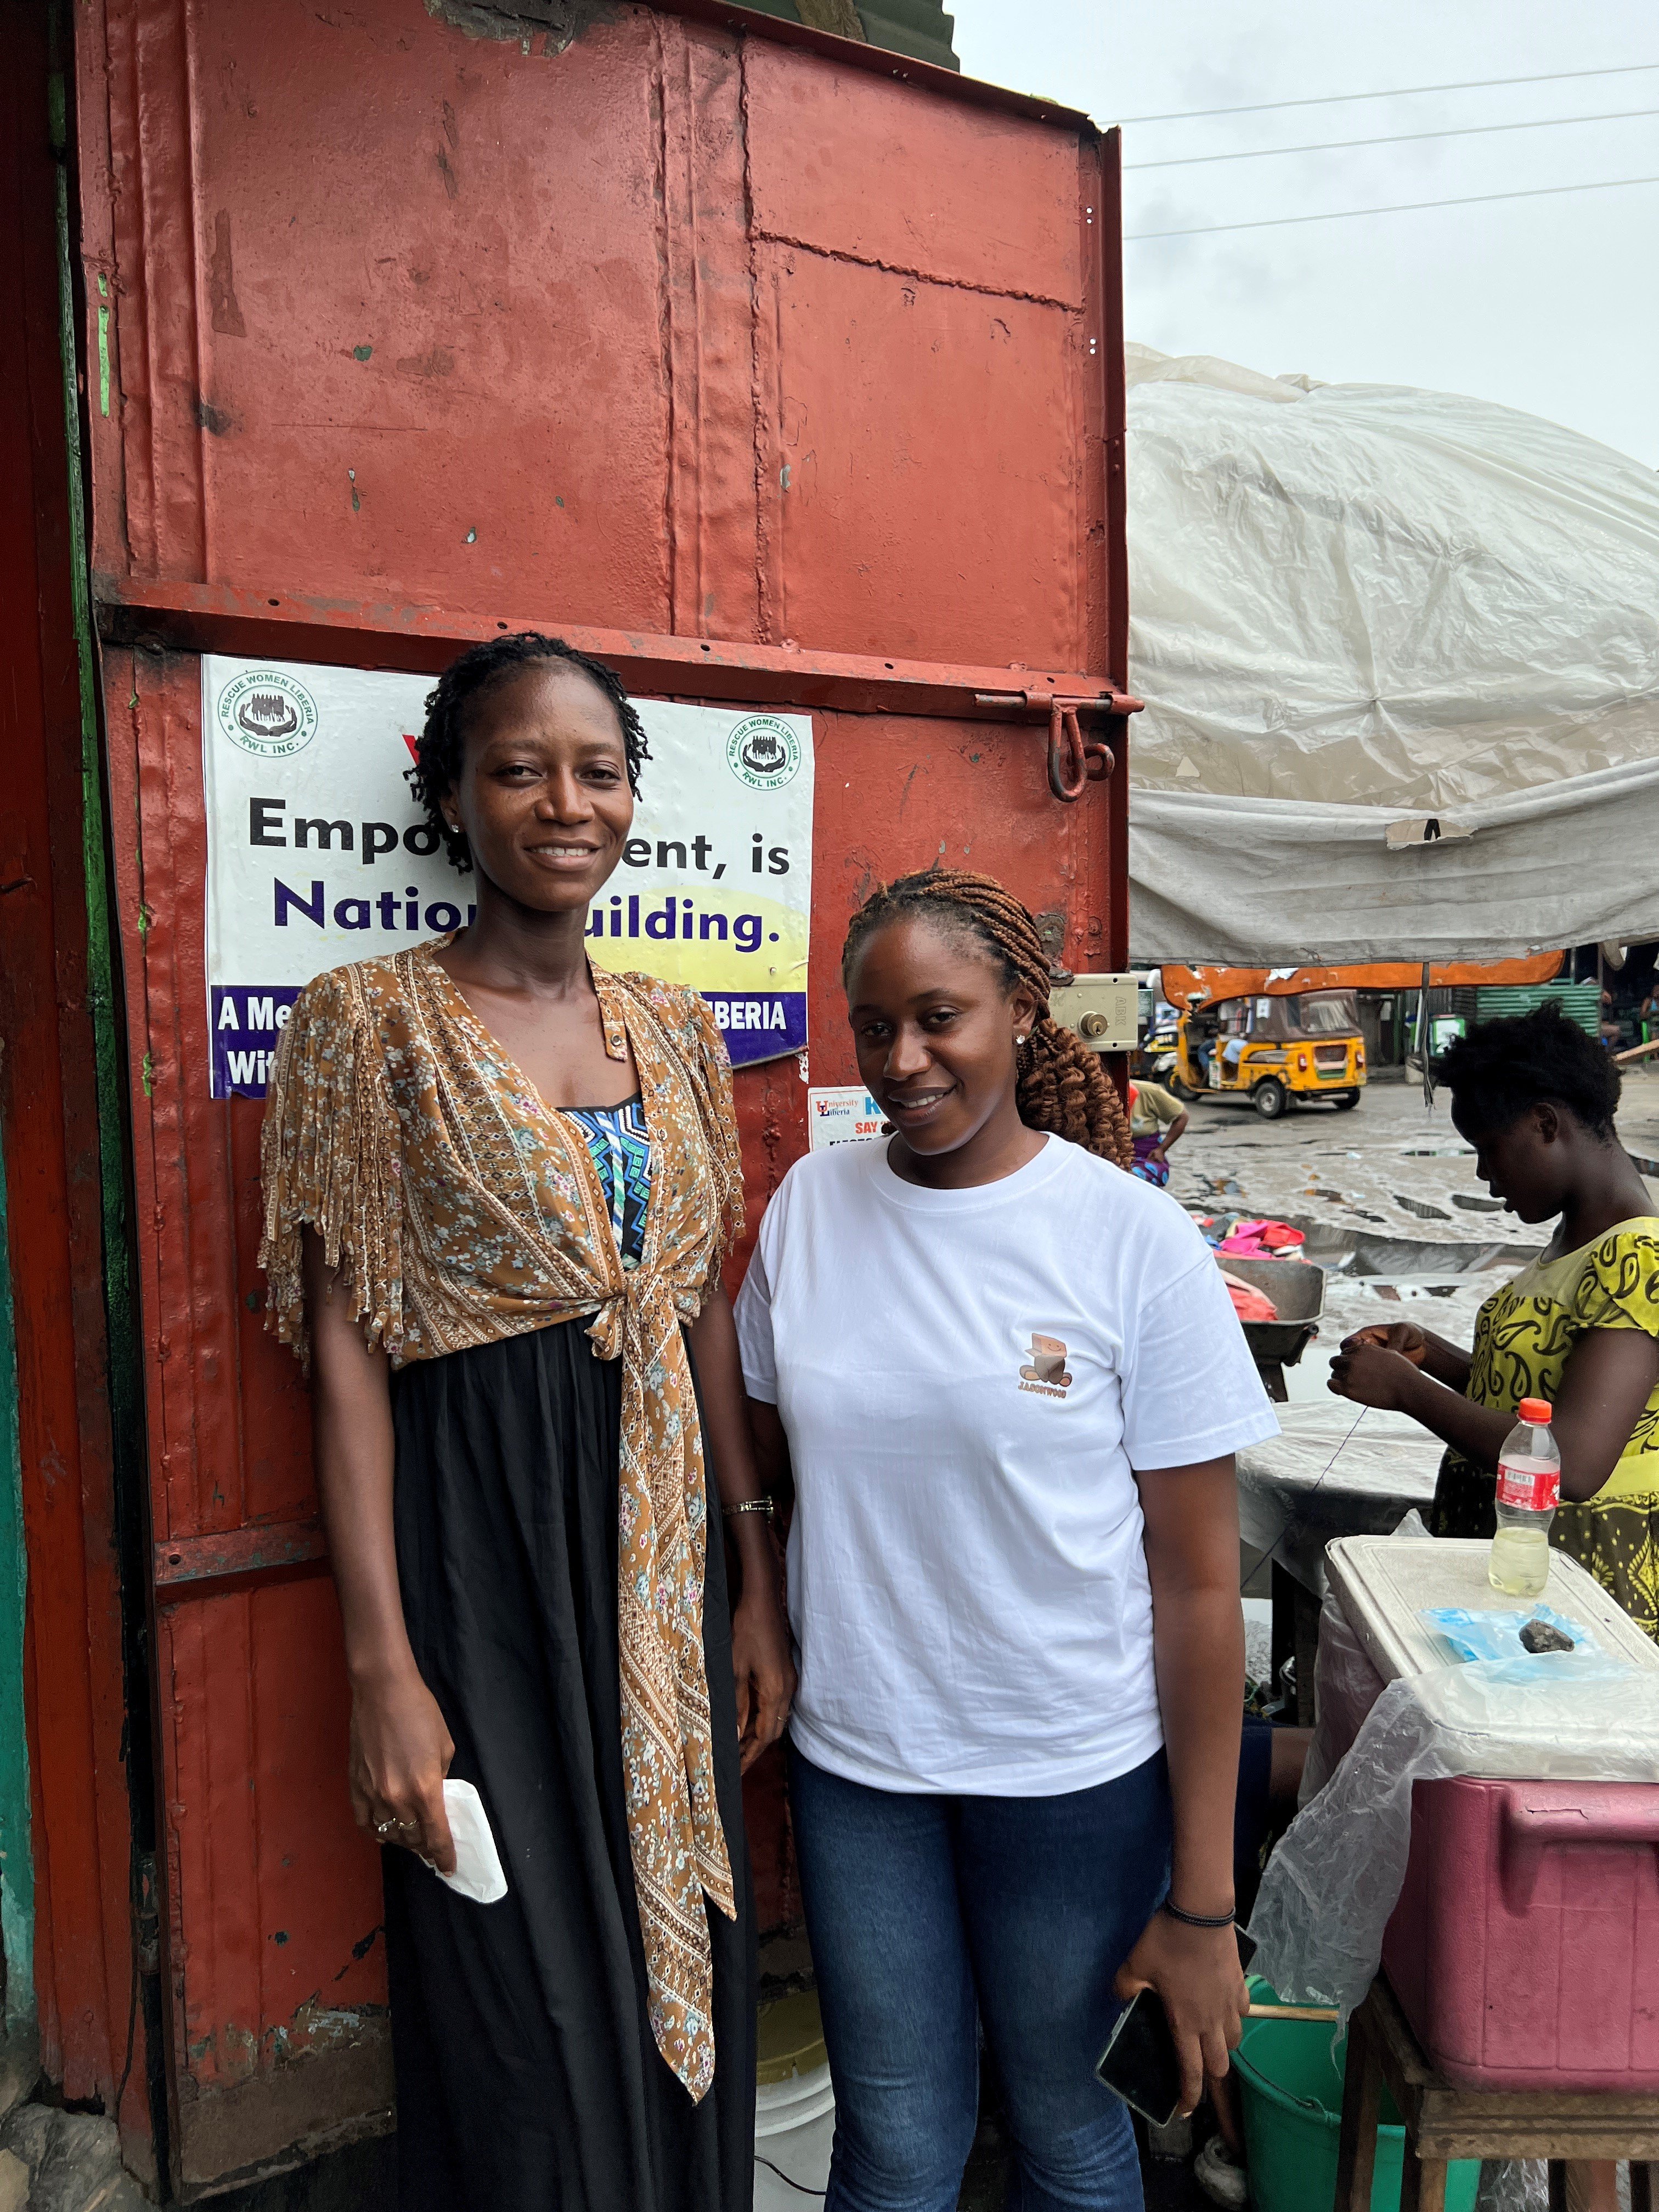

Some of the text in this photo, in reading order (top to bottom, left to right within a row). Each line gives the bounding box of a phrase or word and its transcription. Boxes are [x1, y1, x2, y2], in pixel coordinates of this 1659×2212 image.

[221, 674, 314, 725] RESCUE WOMEN LIBERIA
[240, 735, 299, 754] RWL INC.
[729, 719, 798, 761] RESCUE WOMEN LIBERIA
[742, 771, 763, 787] RWL
[752, 833, 790, 875] is
[585, 895, 780, 952] uilding.
[218, 996, 240, 1030] A
[707, 1001, 787, 1030] BERIA
[1115, 996, 1126, 1026] ABK
[816, 1099, 859, 1113] University
[820, 1105, 850, 1116] Liberia
[855, 1121, 878, 1134] SAY
